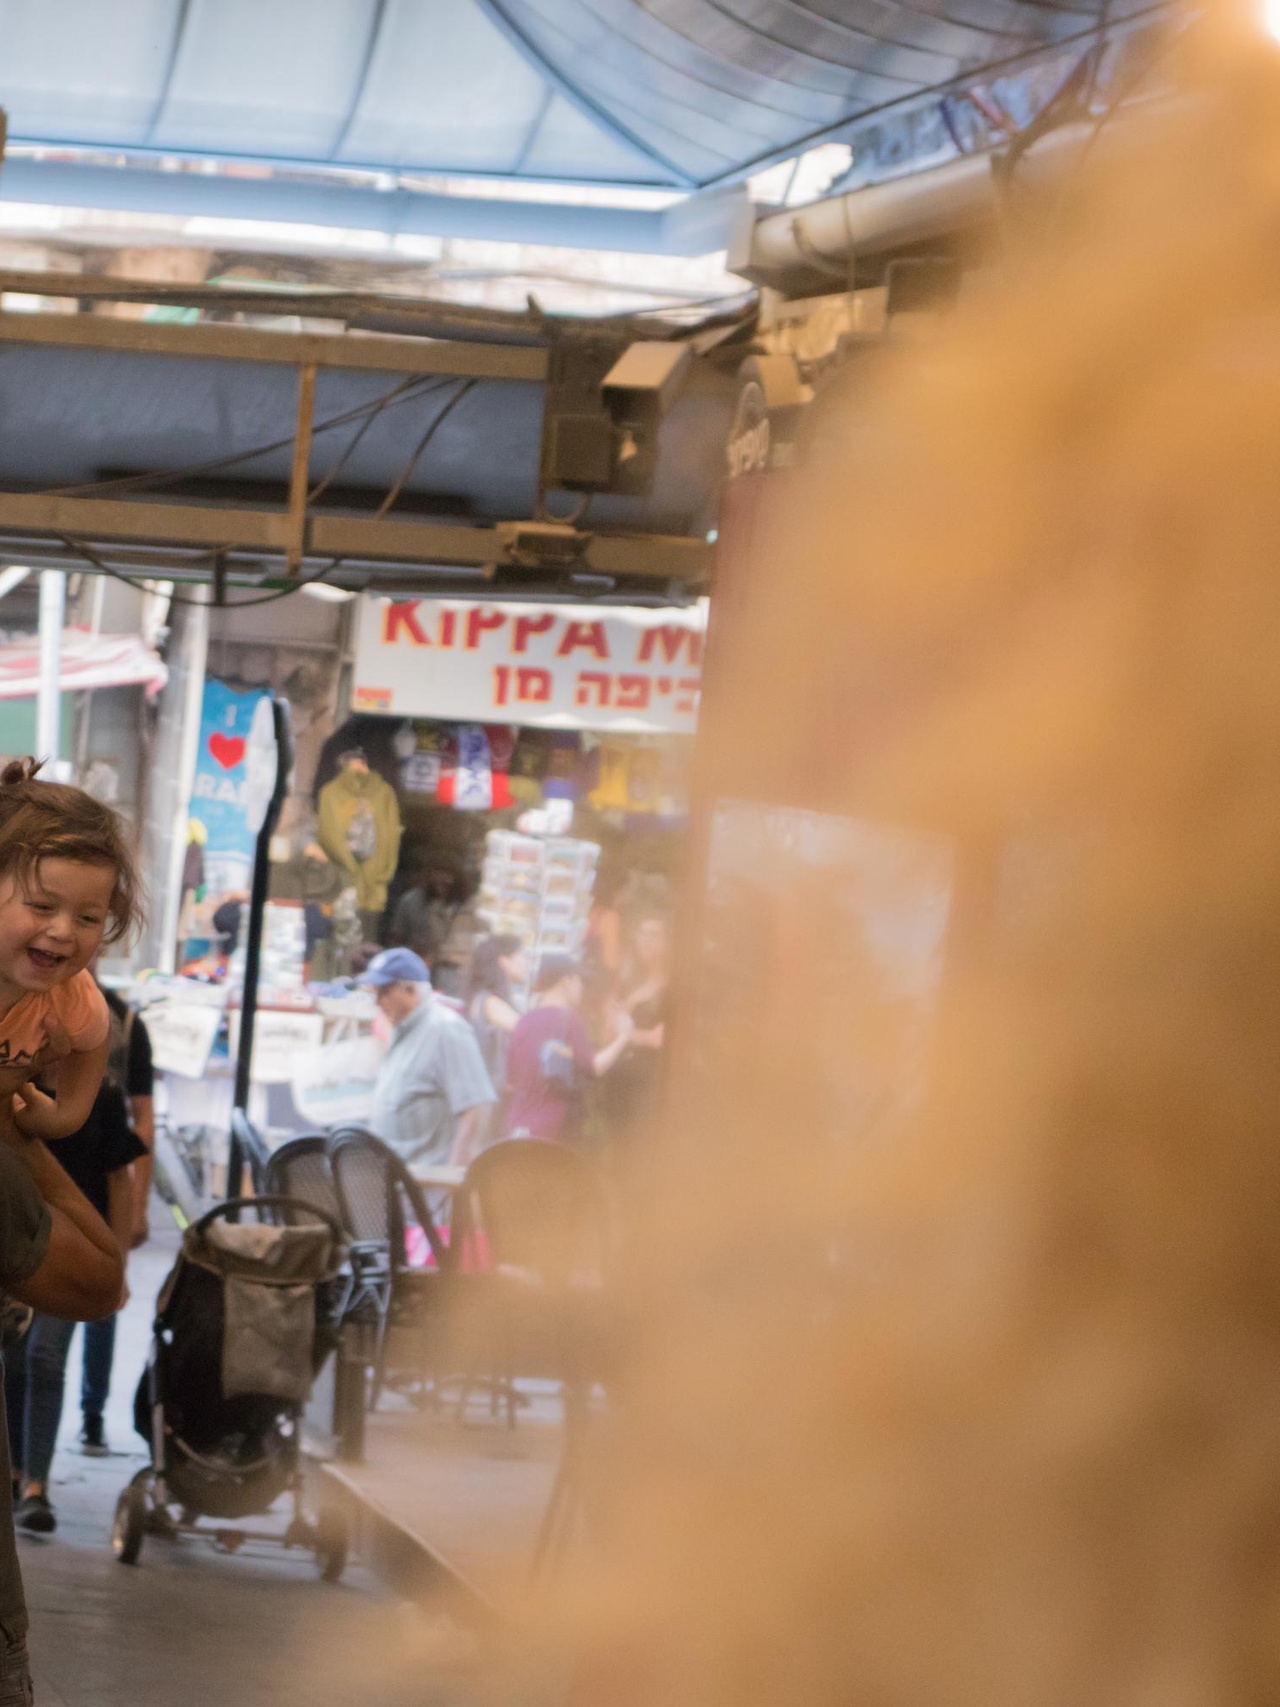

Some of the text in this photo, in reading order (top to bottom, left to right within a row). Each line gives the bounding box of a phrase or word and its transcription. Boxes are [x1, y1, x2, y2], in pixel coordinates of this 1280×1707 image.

[382, 600, 703, 665] KIPPA M
[493, 664, 553, 707] מן
